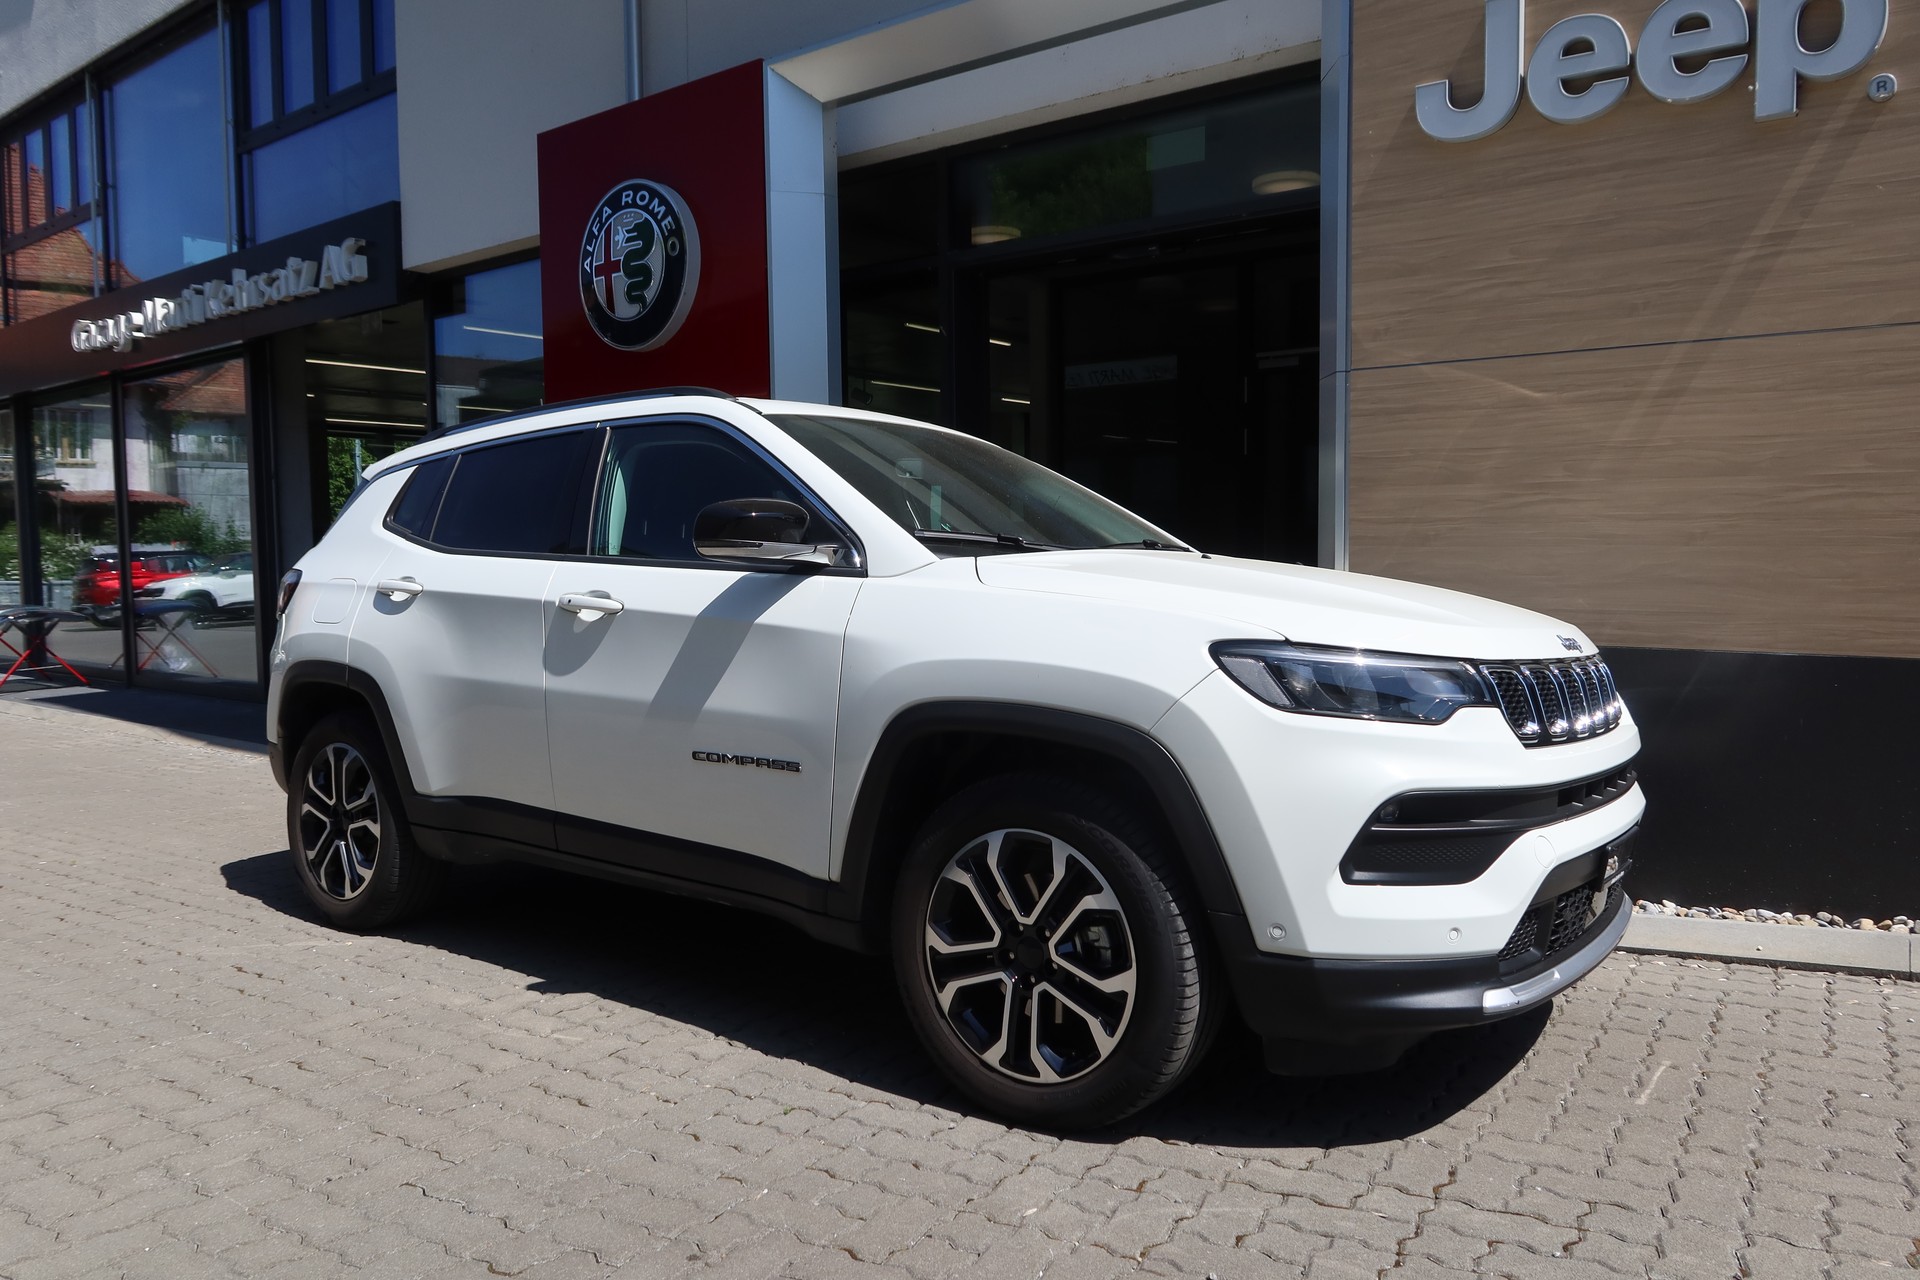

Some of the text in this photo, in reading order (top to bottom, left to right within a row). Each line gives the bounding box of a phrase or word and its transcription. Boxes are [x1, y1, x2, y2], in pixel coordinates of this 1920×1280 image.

[1415, 0, 1888, 142] Jeep
[319, 237, 369, 290] AG
[584, 190, 680, 274] ALFA ROMEO
[691, 750, 802, 773] COMPASS
